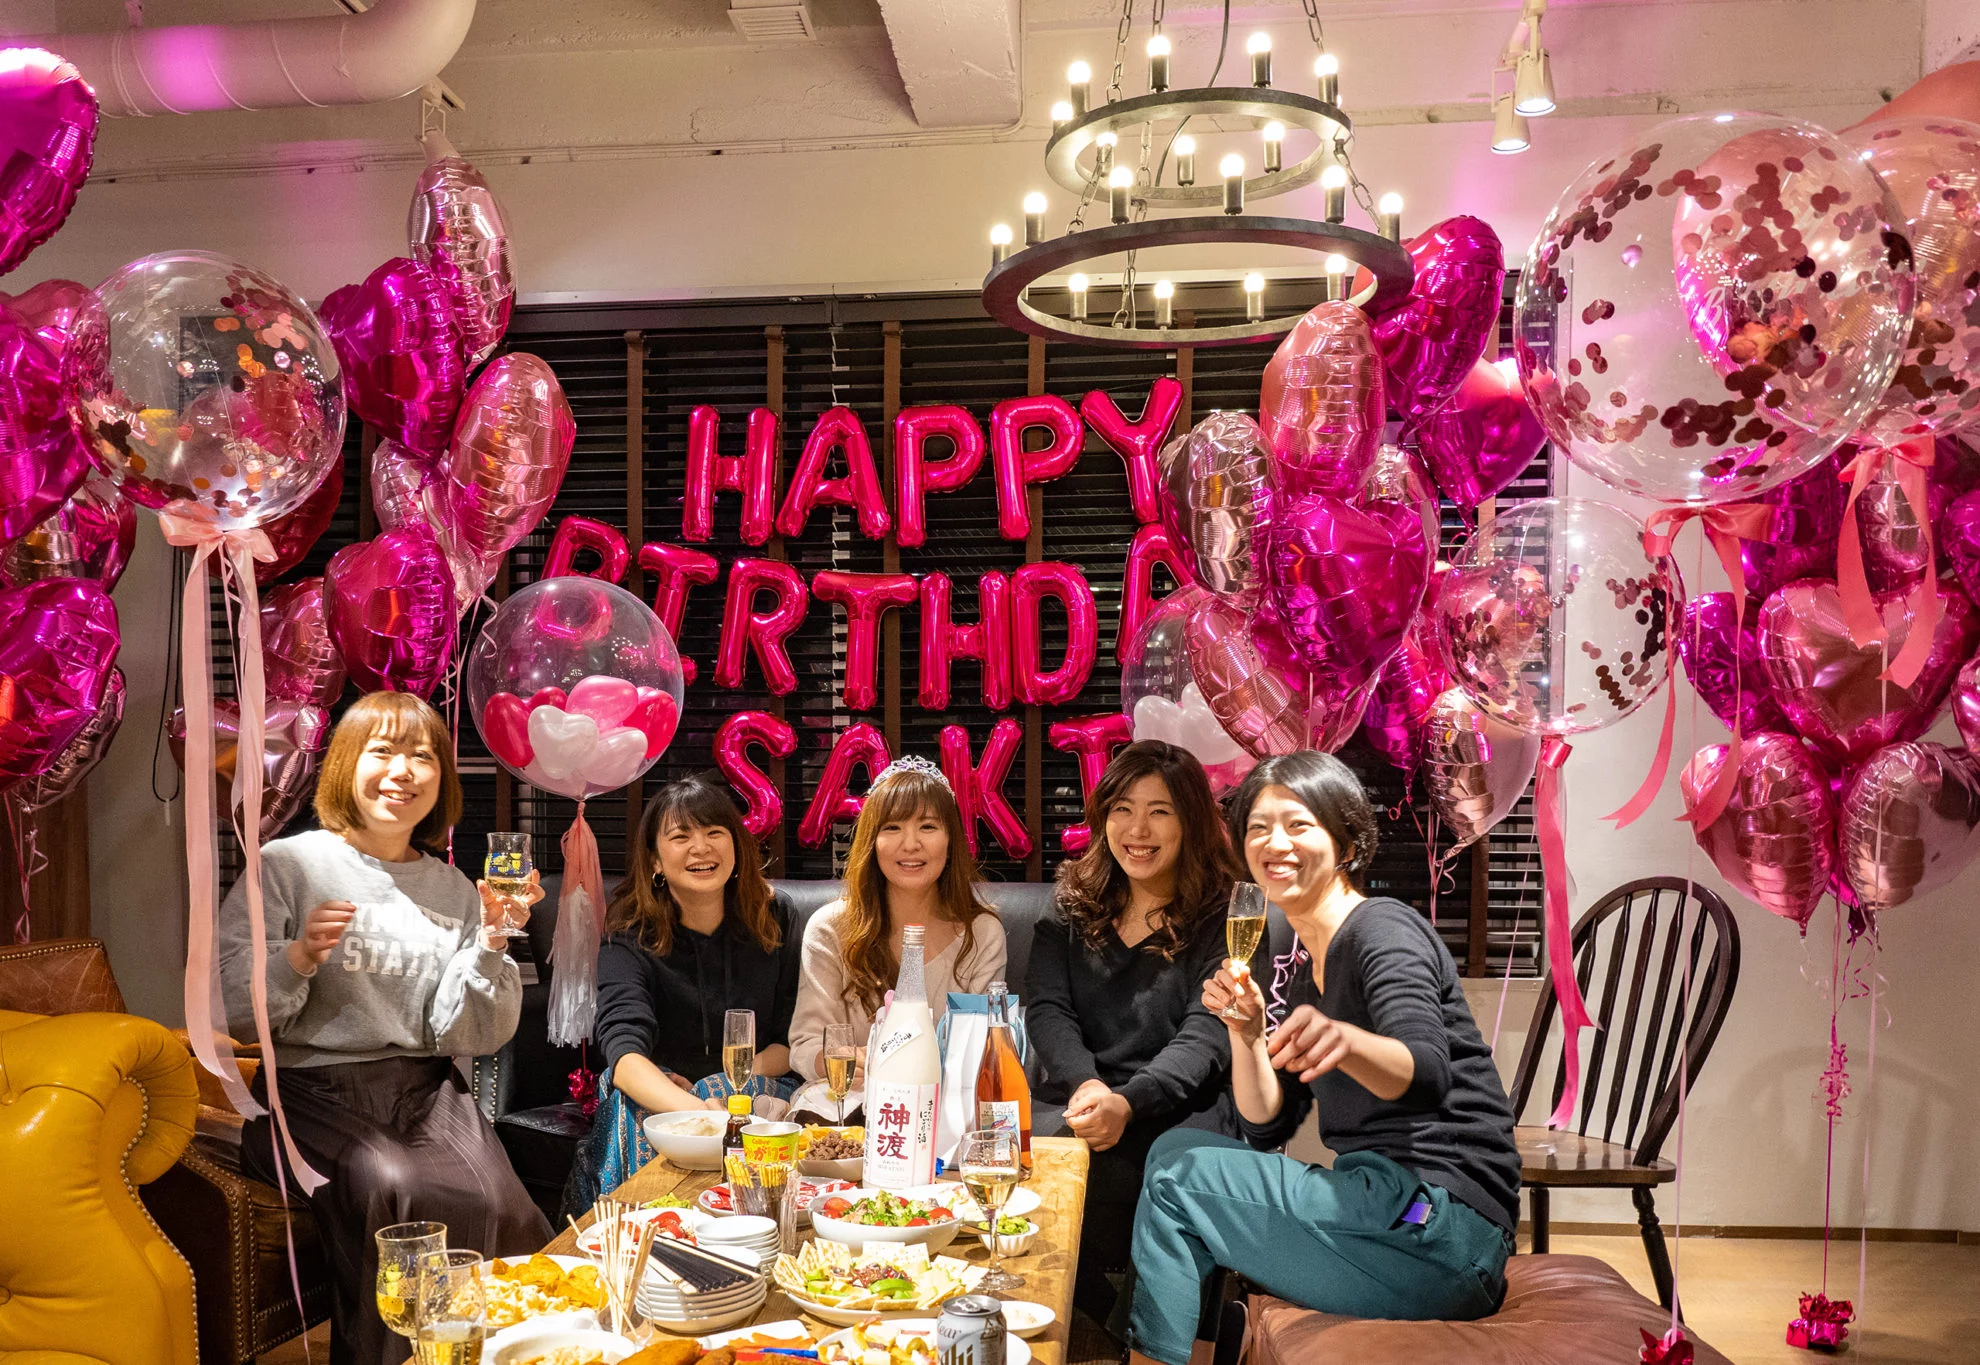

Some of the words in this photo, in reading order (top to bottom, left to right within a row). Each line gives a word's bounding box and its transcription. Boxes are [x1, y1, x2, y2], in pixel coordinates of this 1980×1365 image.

[681, 376, 1184, 548] HAPPY
[541, 514, 1210, 711] BIRTHDA
[713, 709, 1133, 859] SAKI
[877, 1102, 910, 1160] 神渡
